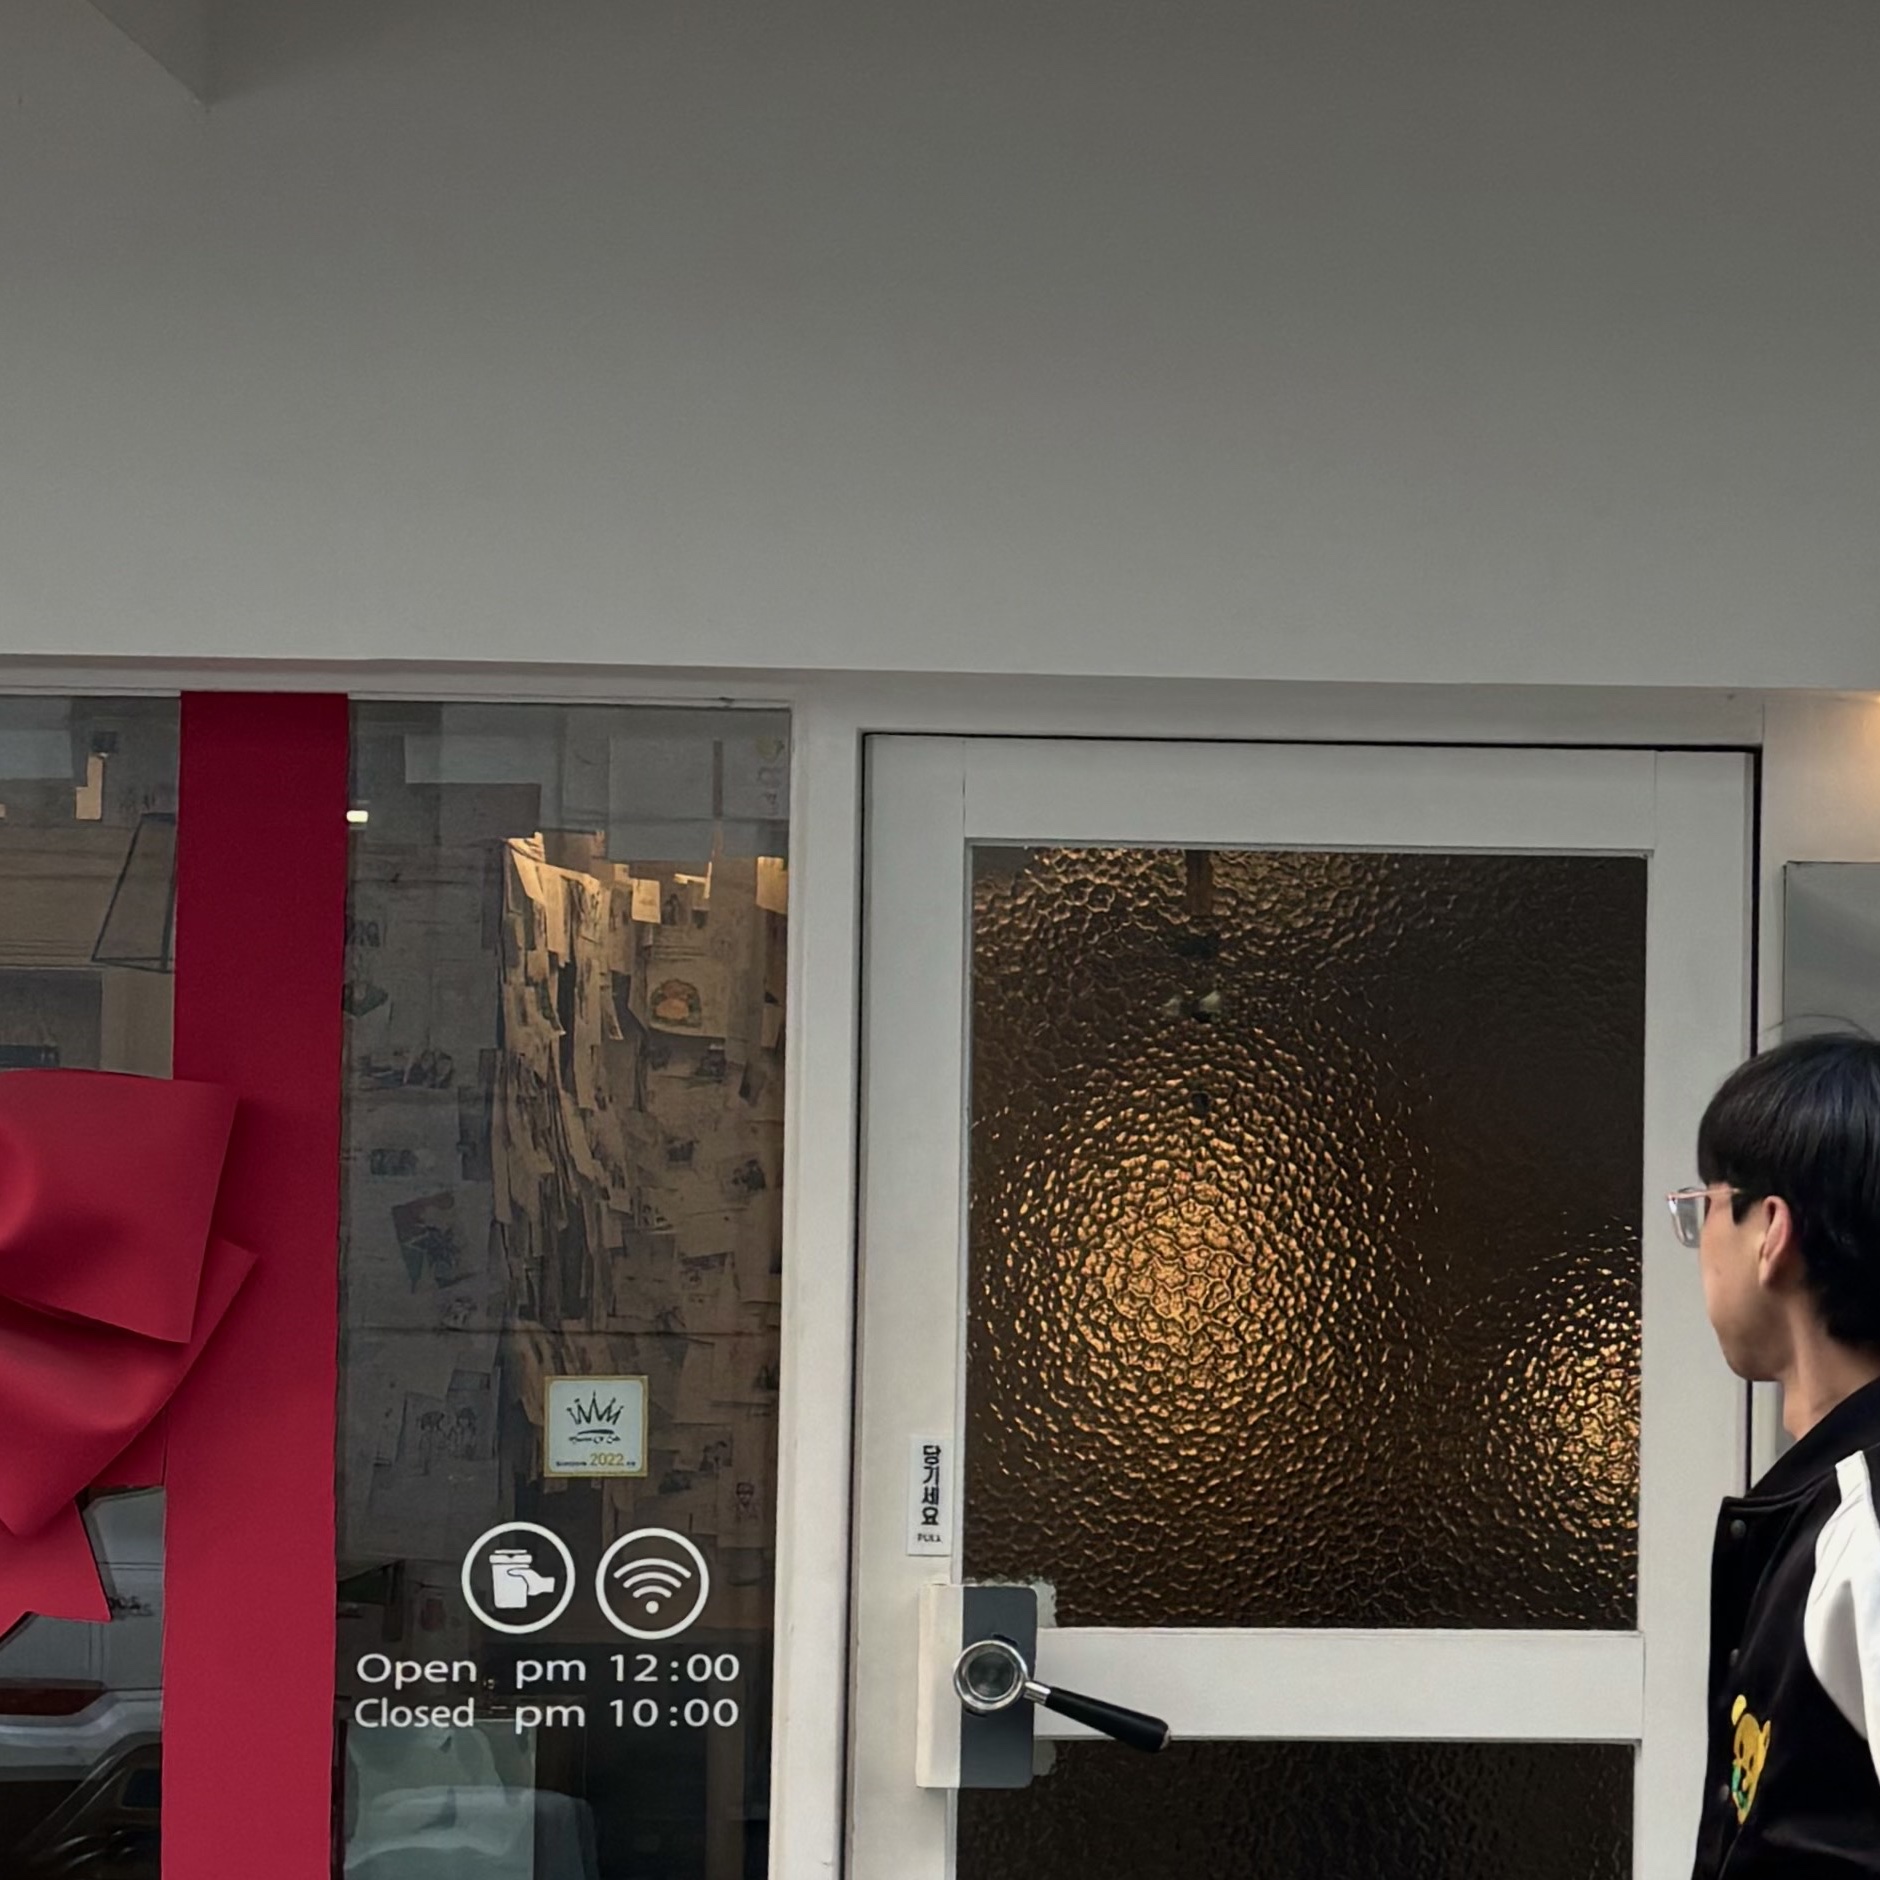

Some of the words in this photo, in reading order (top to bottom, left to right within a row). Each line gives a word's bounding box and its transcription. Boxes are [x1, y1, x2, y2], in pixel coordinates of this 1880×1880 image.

[589, 1453, 625, 1467] 2022
[920, 1444, 942, 1526] 당기세요
[355, 1653, 477, 1690] Open
[515, 1658, 586, 1690] pm
[609, 1653, 740, 1683] 12:00
[354, 1697, 475, 1728] Closed
[514, 1703, 586, 1735] pm
[609, 1698, 740, 1728] 10:00
